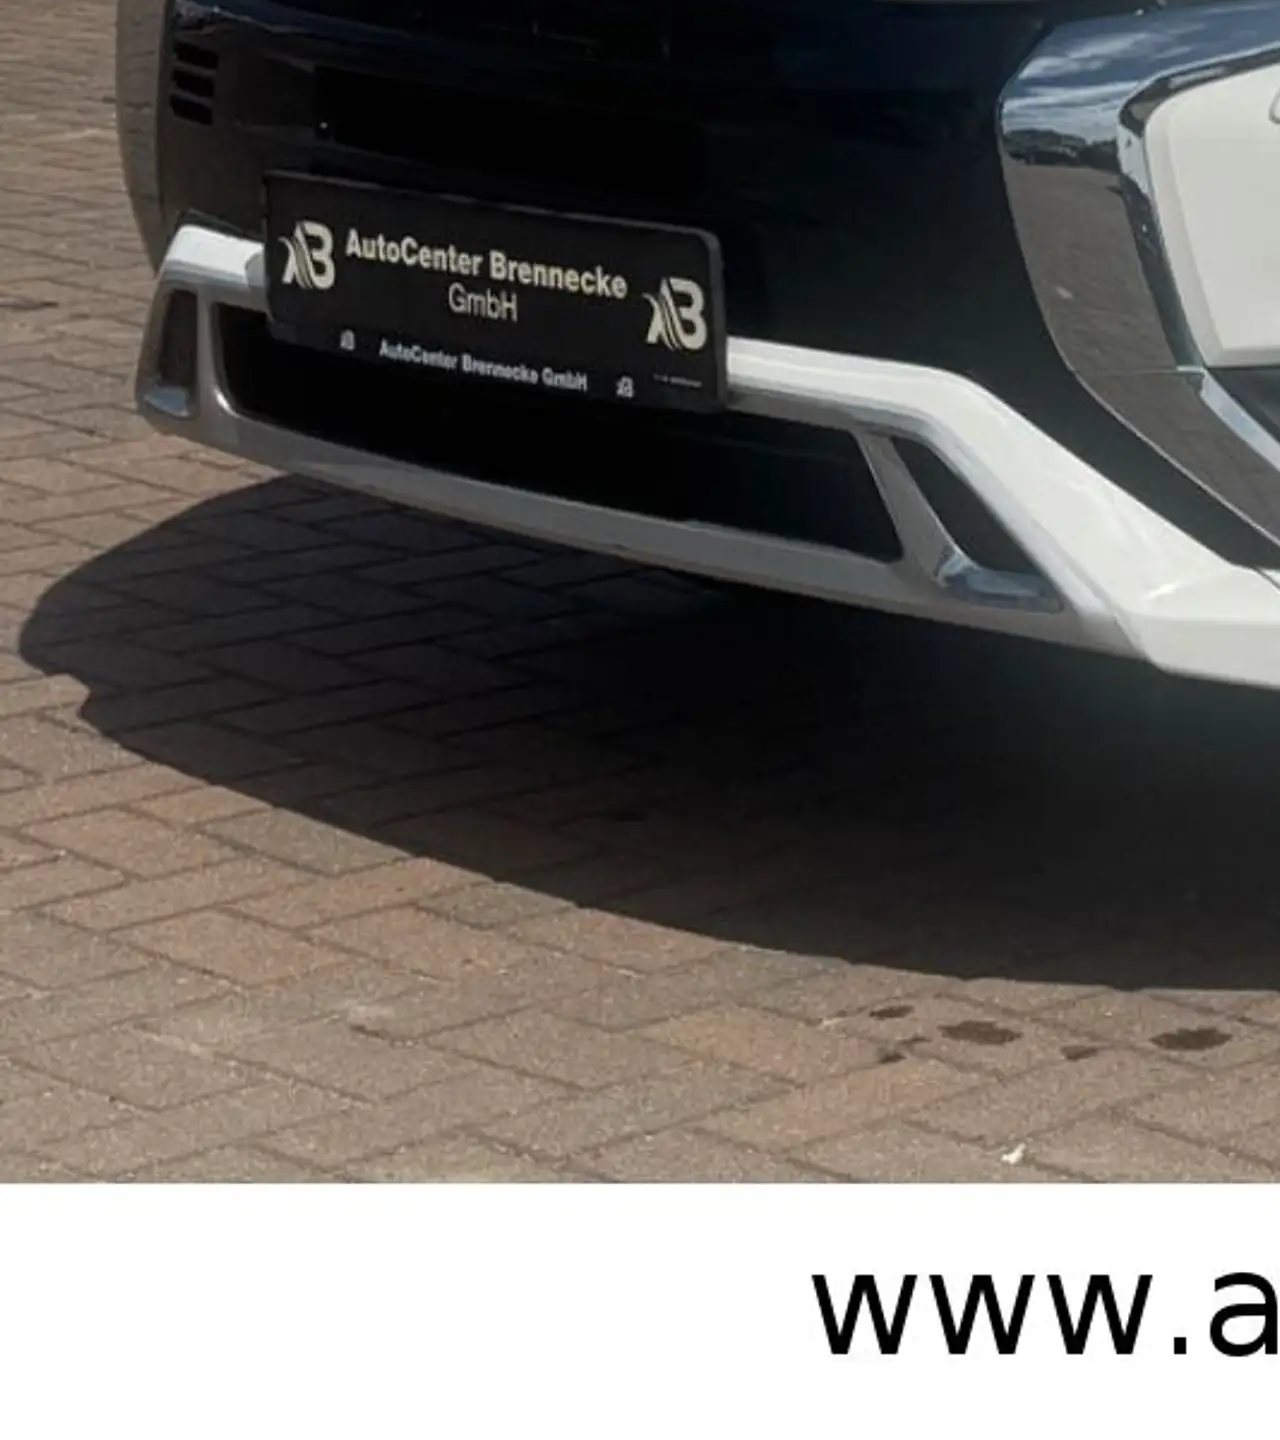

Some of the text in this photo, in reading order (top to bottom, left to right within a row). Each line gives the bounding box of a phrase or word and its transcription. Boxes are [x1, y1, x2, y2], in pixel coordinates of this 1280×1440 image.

[345, 229, 628, 298] AutoCenter Brennecke
[448, 284, 518, 322] GmbH
[379, 338, 458, 370] AutoCenter
[462, 354, 538, 384] Brennecke
[541, 367, 588, 392] GmbH
